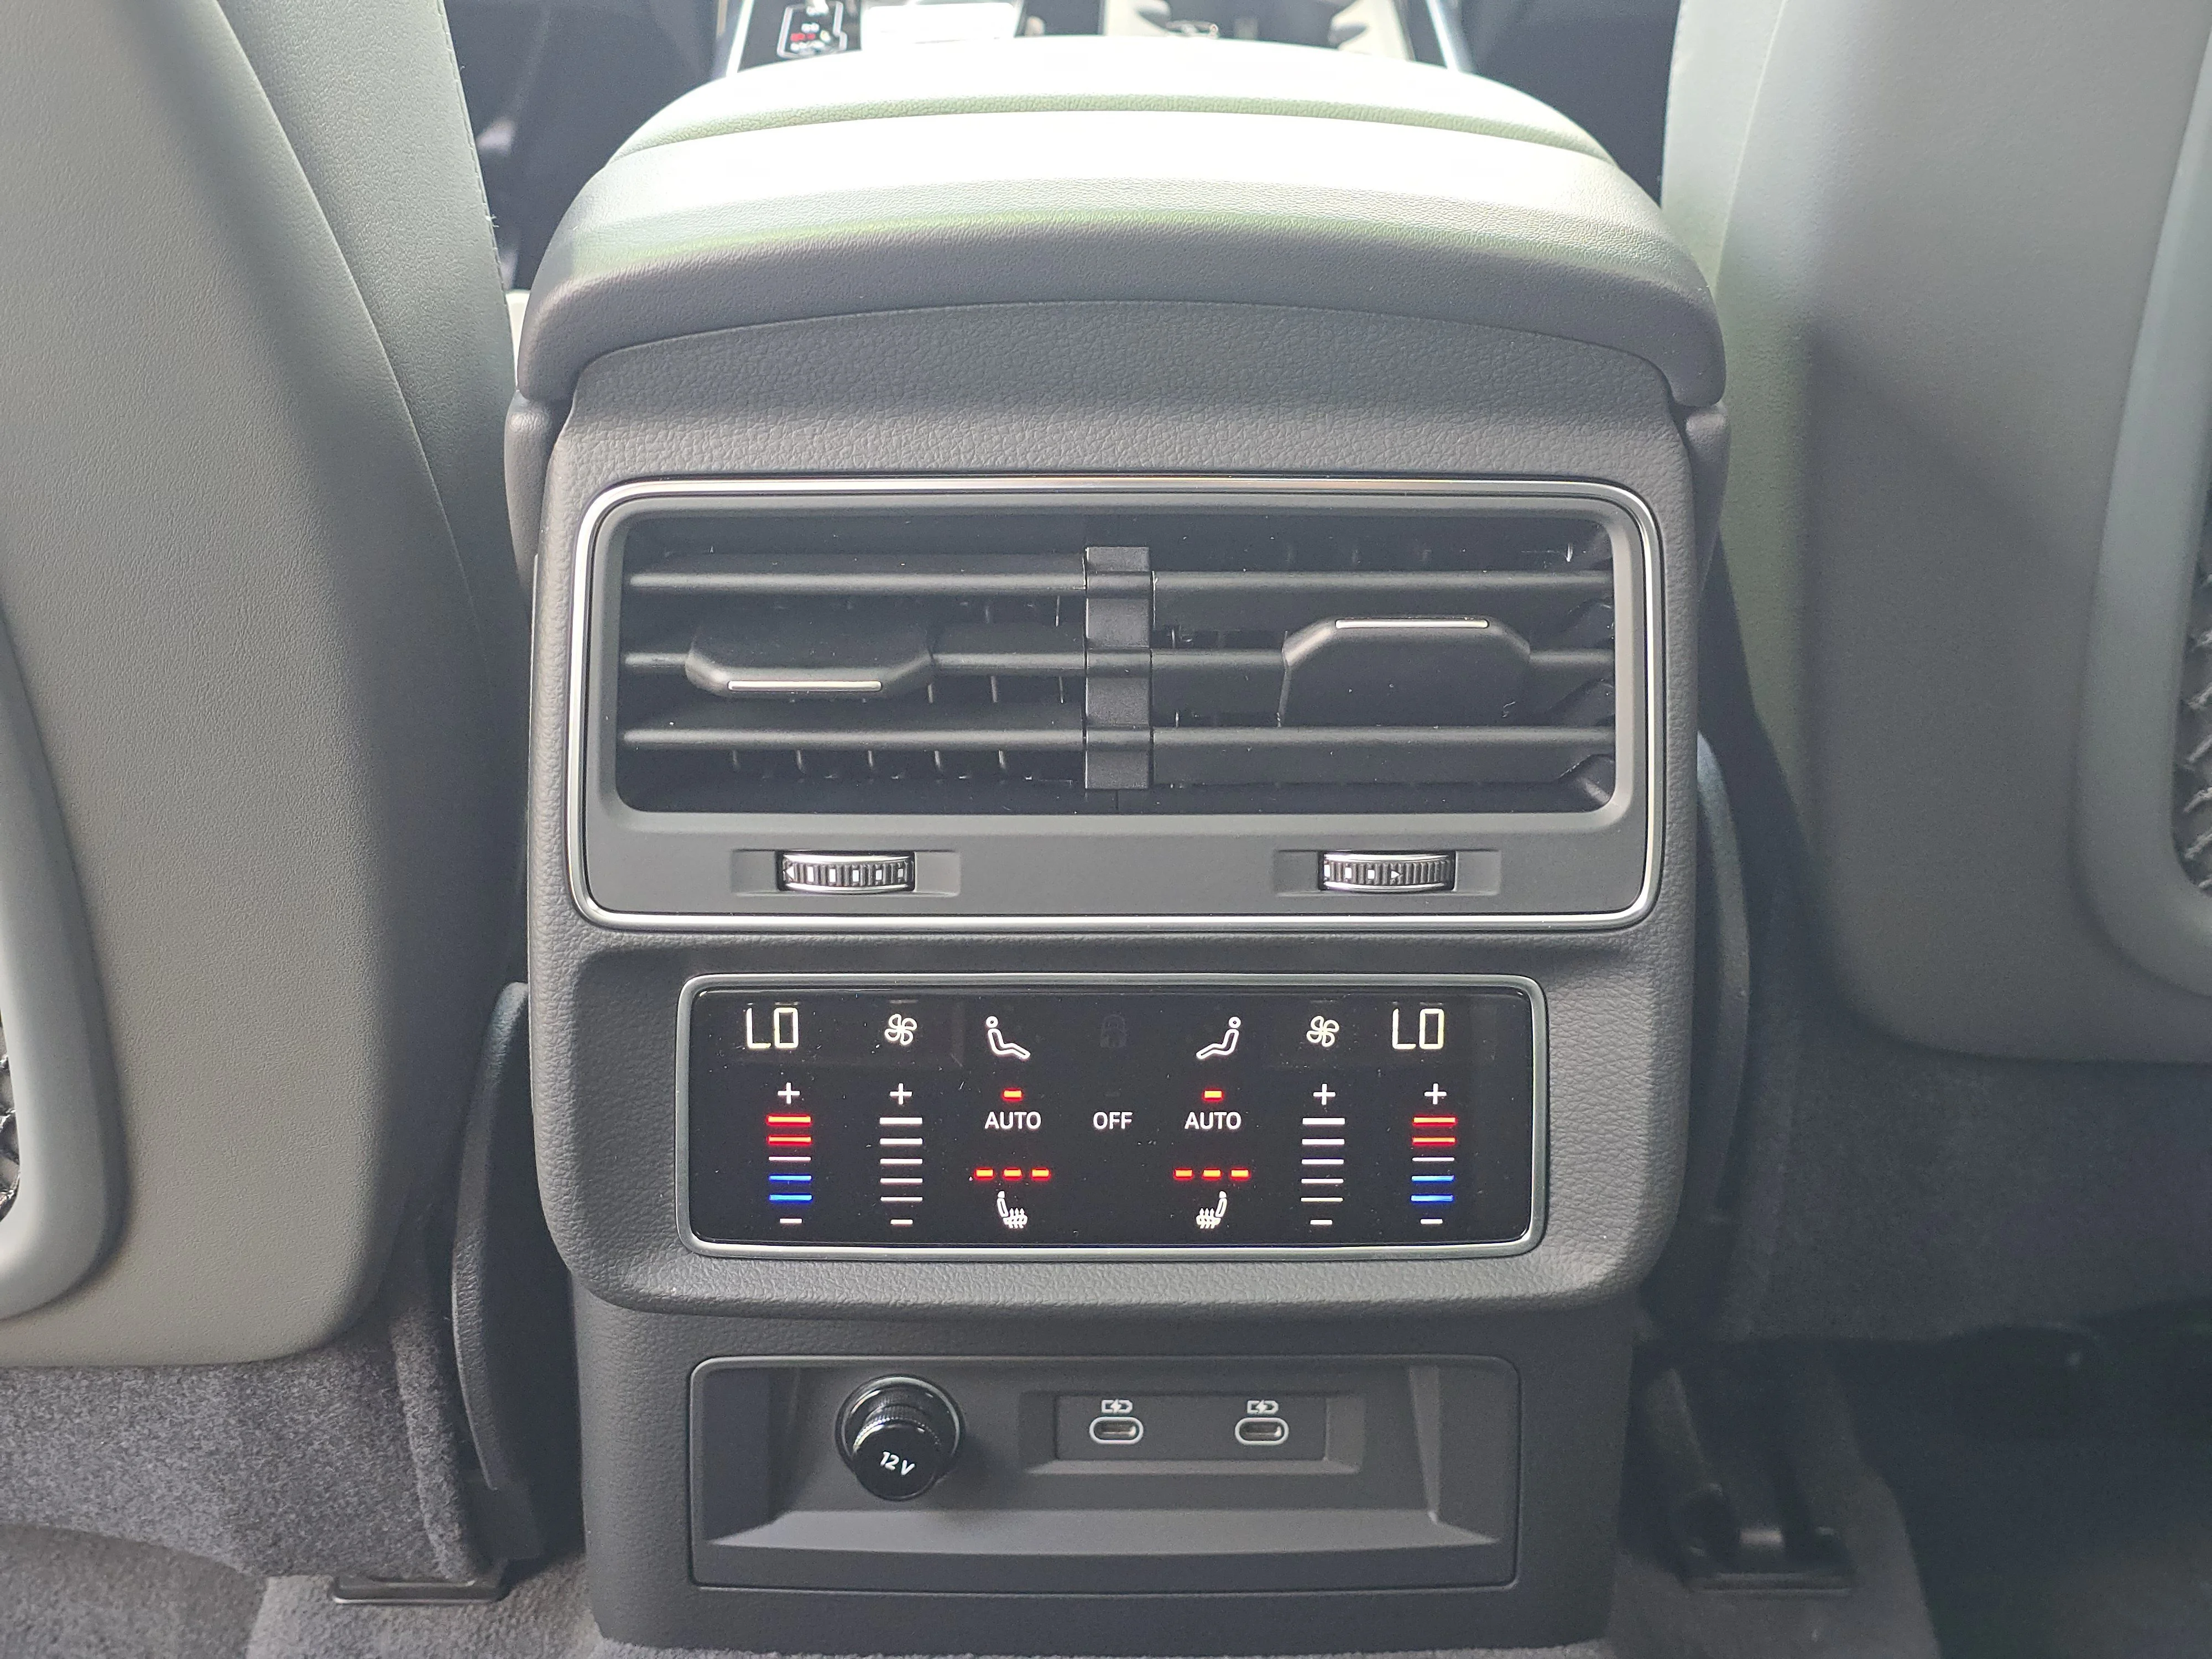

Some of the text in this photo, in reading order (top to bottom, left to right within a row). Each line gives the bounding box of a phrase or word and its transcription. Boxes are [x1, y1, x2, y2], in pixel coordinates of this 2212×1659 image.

[745, 1007, 799, 1050] LO
[1392, 1008, 1444, 1050] LO
[984, 1110, 1042, 1130] AUTO
[1093, 1111, 1134, 1130] OFF
[1184, 1111, 1242, 1130] AUTO
